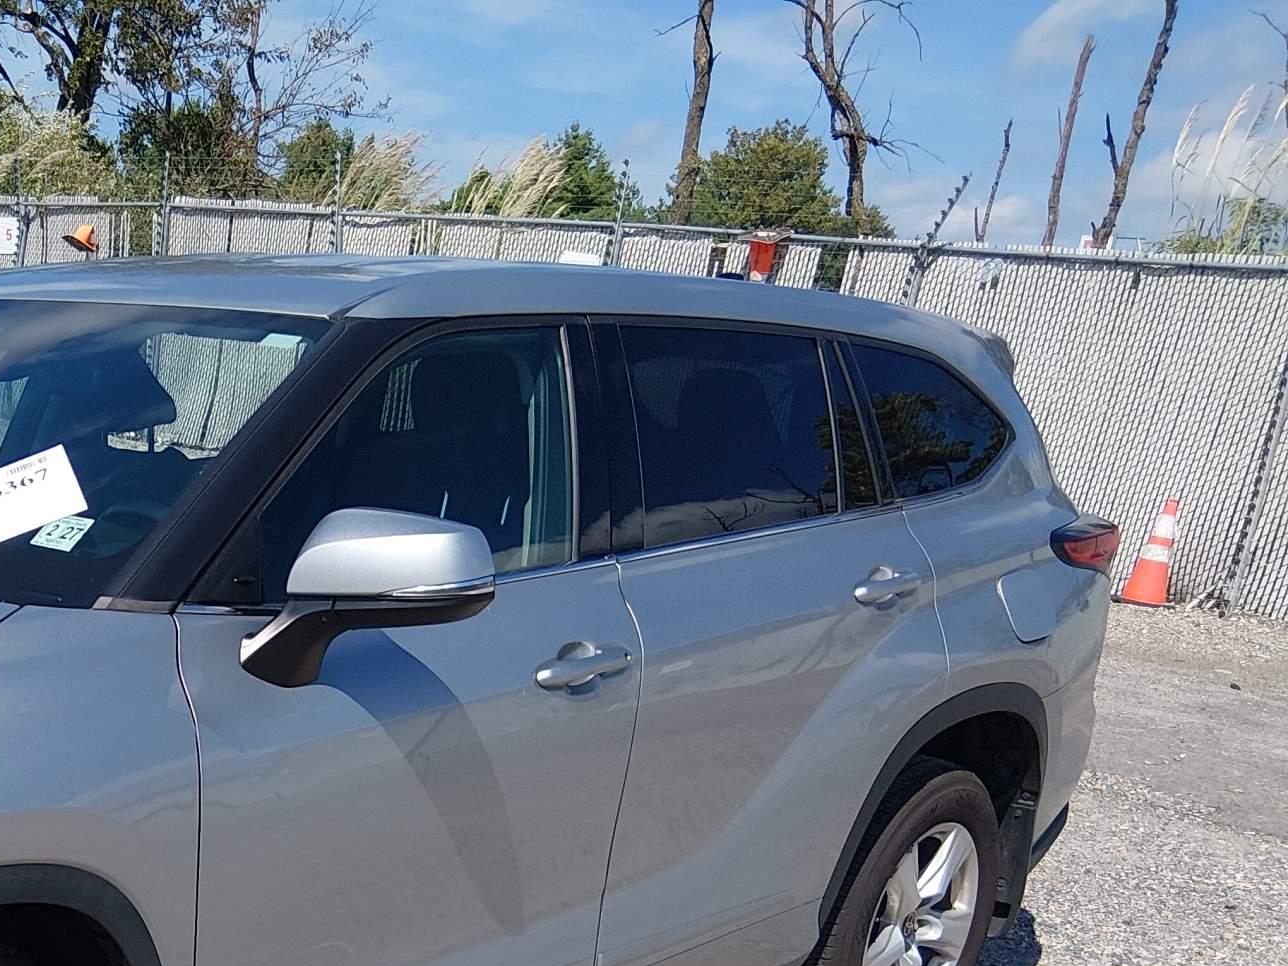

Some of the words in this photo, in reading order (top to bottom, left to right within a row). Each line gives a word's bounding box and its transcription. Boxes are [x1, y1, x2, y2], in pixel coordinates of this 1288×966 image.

[6, 228, 12, 241] 5
[45, 524, 60, 537] 2
[57, 526, 85, 541] 27
